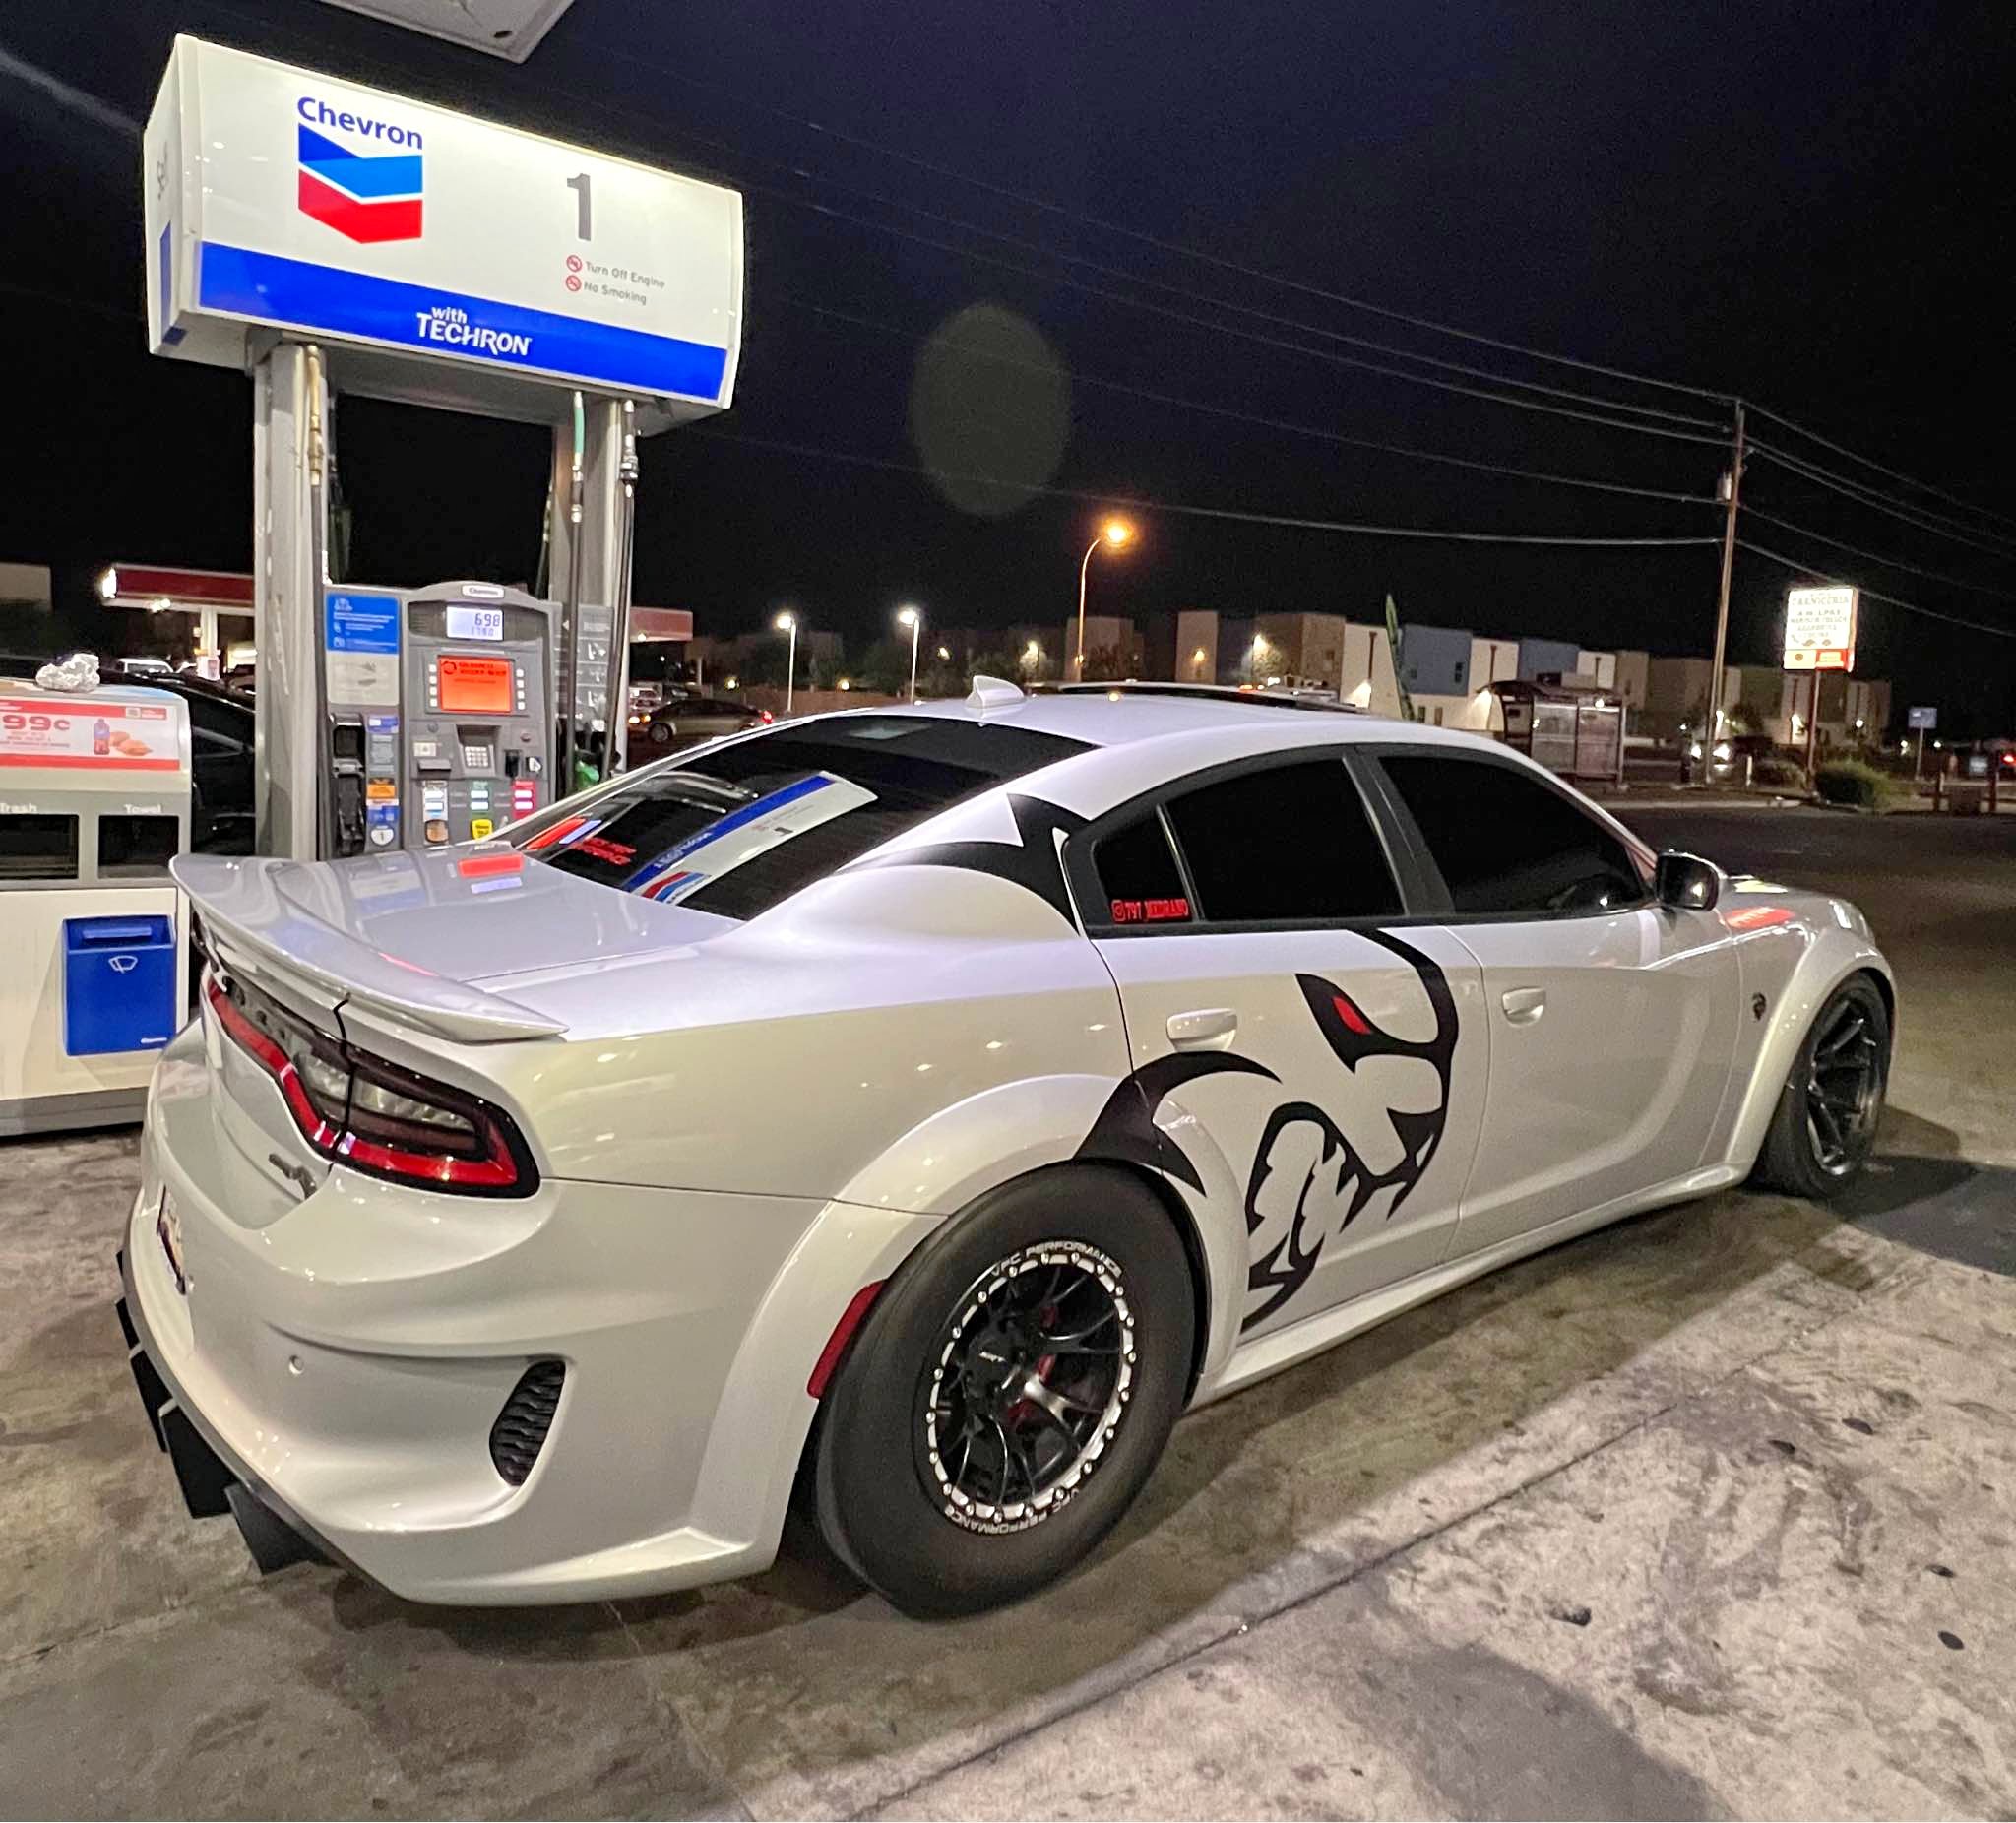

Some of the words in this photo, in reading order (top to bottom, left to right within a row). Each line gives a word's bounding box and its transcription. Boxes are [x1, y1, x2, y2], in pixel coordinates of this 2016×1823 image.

[297, 96, 423, 150] Chevron
[567, 173, 592, 241] 1
[585, 260, 609, 276] Turn
[611, 267, 628, 281] Off
[630, 272, 665, 289] Engine
[583, 281, 599, 293] No
[601, 284, 647, 306] Smoking
[431, 306, 468, 324] with
[416, 312, 532, 356] TECHRON
[0, 802, 38, 814] Trash
[124, 803, 163, 815] Towel
